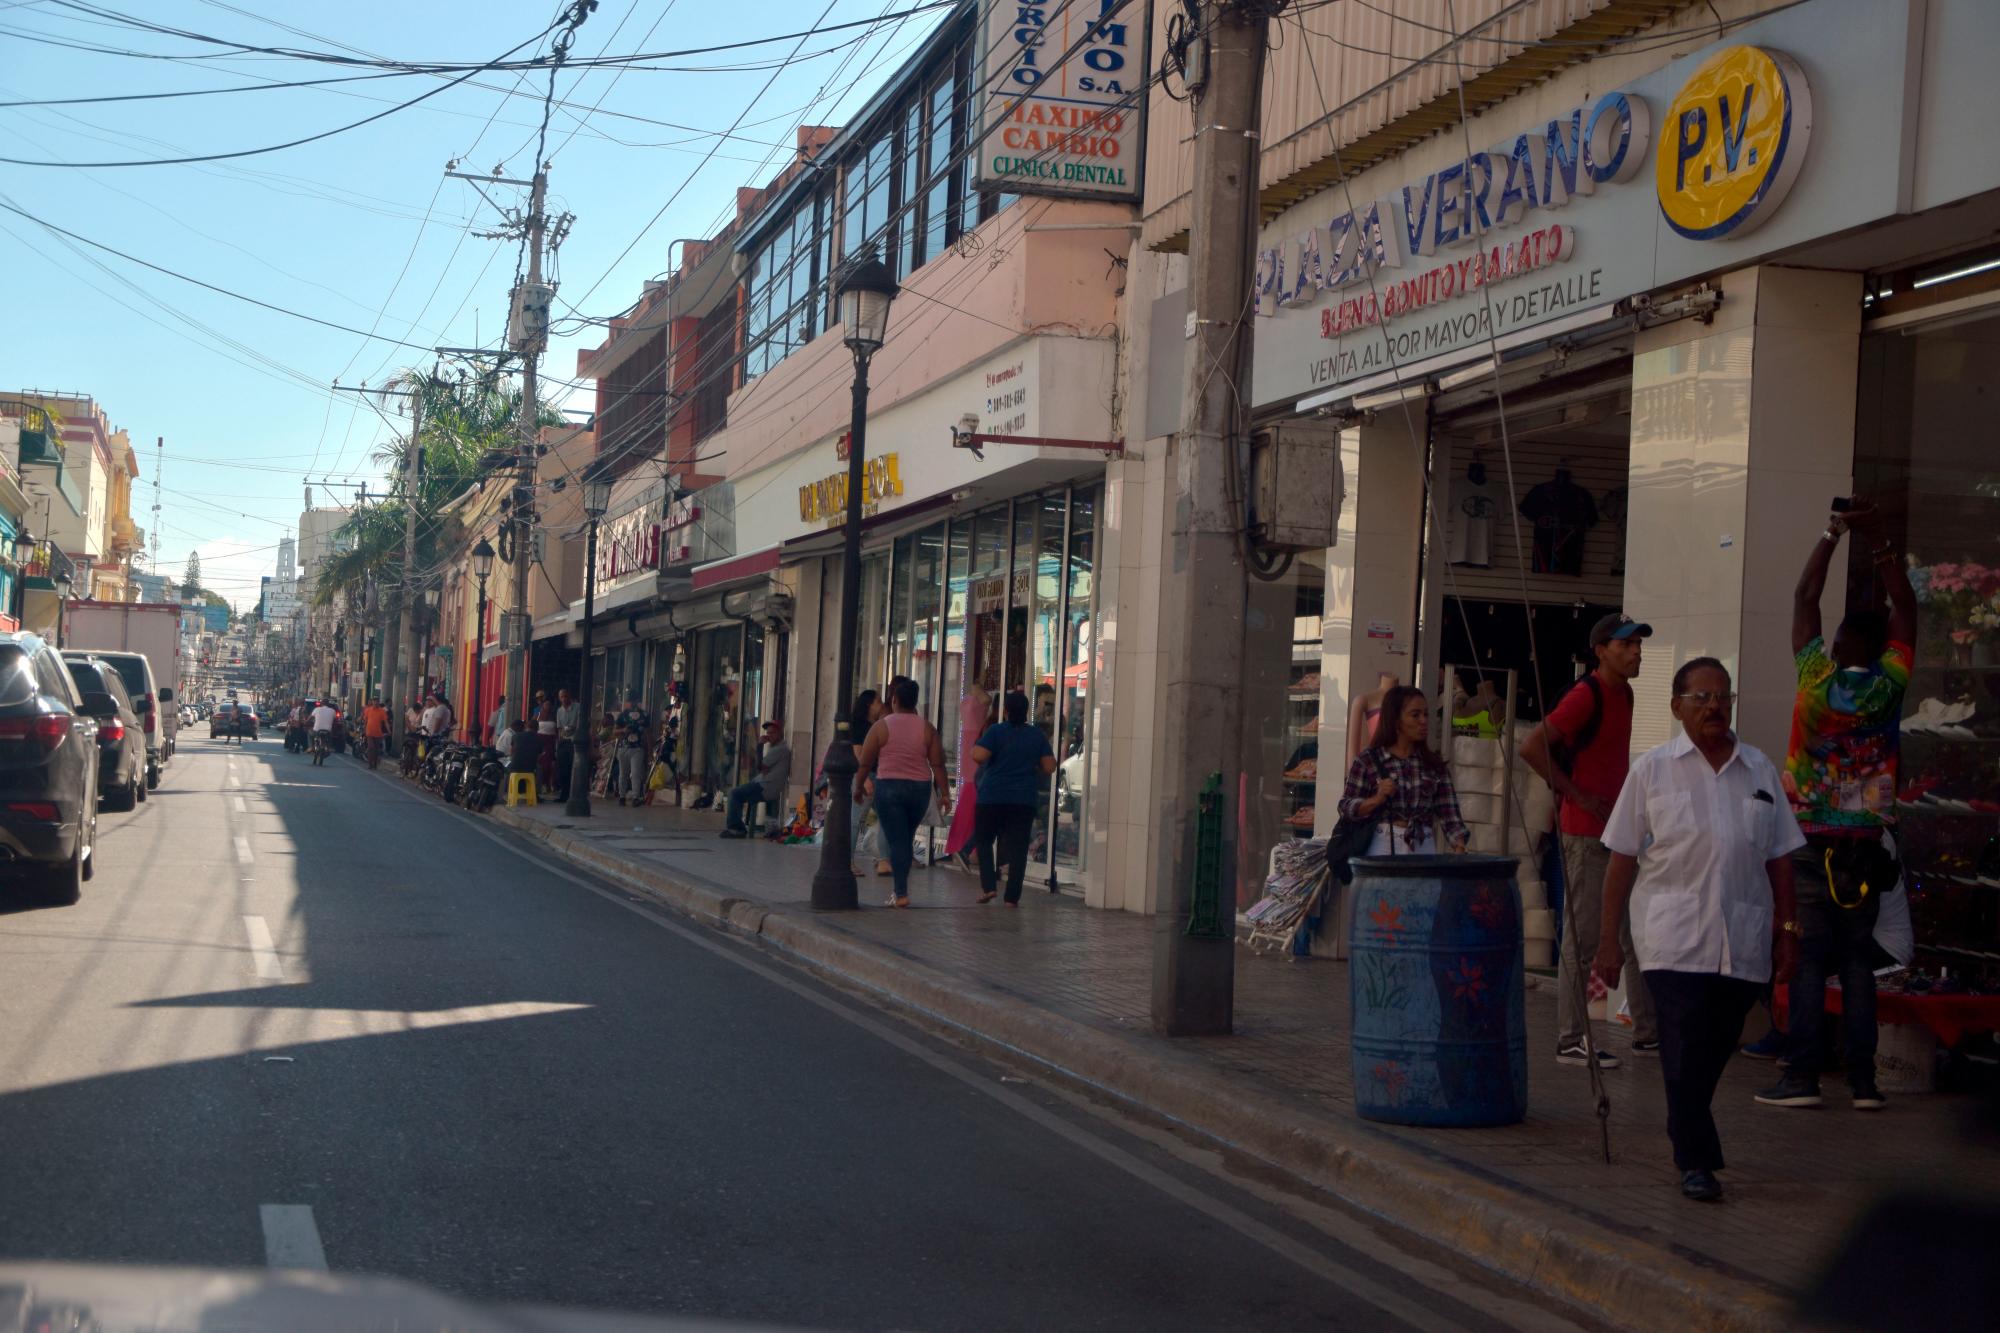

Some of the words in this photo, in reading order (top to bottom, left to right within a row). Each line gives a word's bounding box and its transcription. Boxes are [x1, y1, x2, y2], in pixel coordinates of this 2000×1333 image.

[1012, 0, 1048, 86] RCIO
[1079, 77, 1132, 95] S.A.
[1003, 101, 1123, 133] MAXIMO
[1003, 127, 1120, 158] CAMBIO
[1676, 83, 1758, 193] P.V.
[993, 156, 1060, 180] CLINICA
[1064, 163, 1127, 186] DENTAL
[1254, 200, 1390, 314] PLAZA
[1403, 92, 1640, 256] VERANO
[1384, 263, 1456, 317] BONITO
[1457, 256, 1472, 292] Y
[1310, 348, 1358, 385] VENTA
[1361, 341, 1383, 369] AL
[1386, 330, 1421, 363] POR
[1424, 306, 1490, 348] MAYOR
[1495, 302, 1509, 328] Y
[1512, 269, 1602, 323] DETALLE
